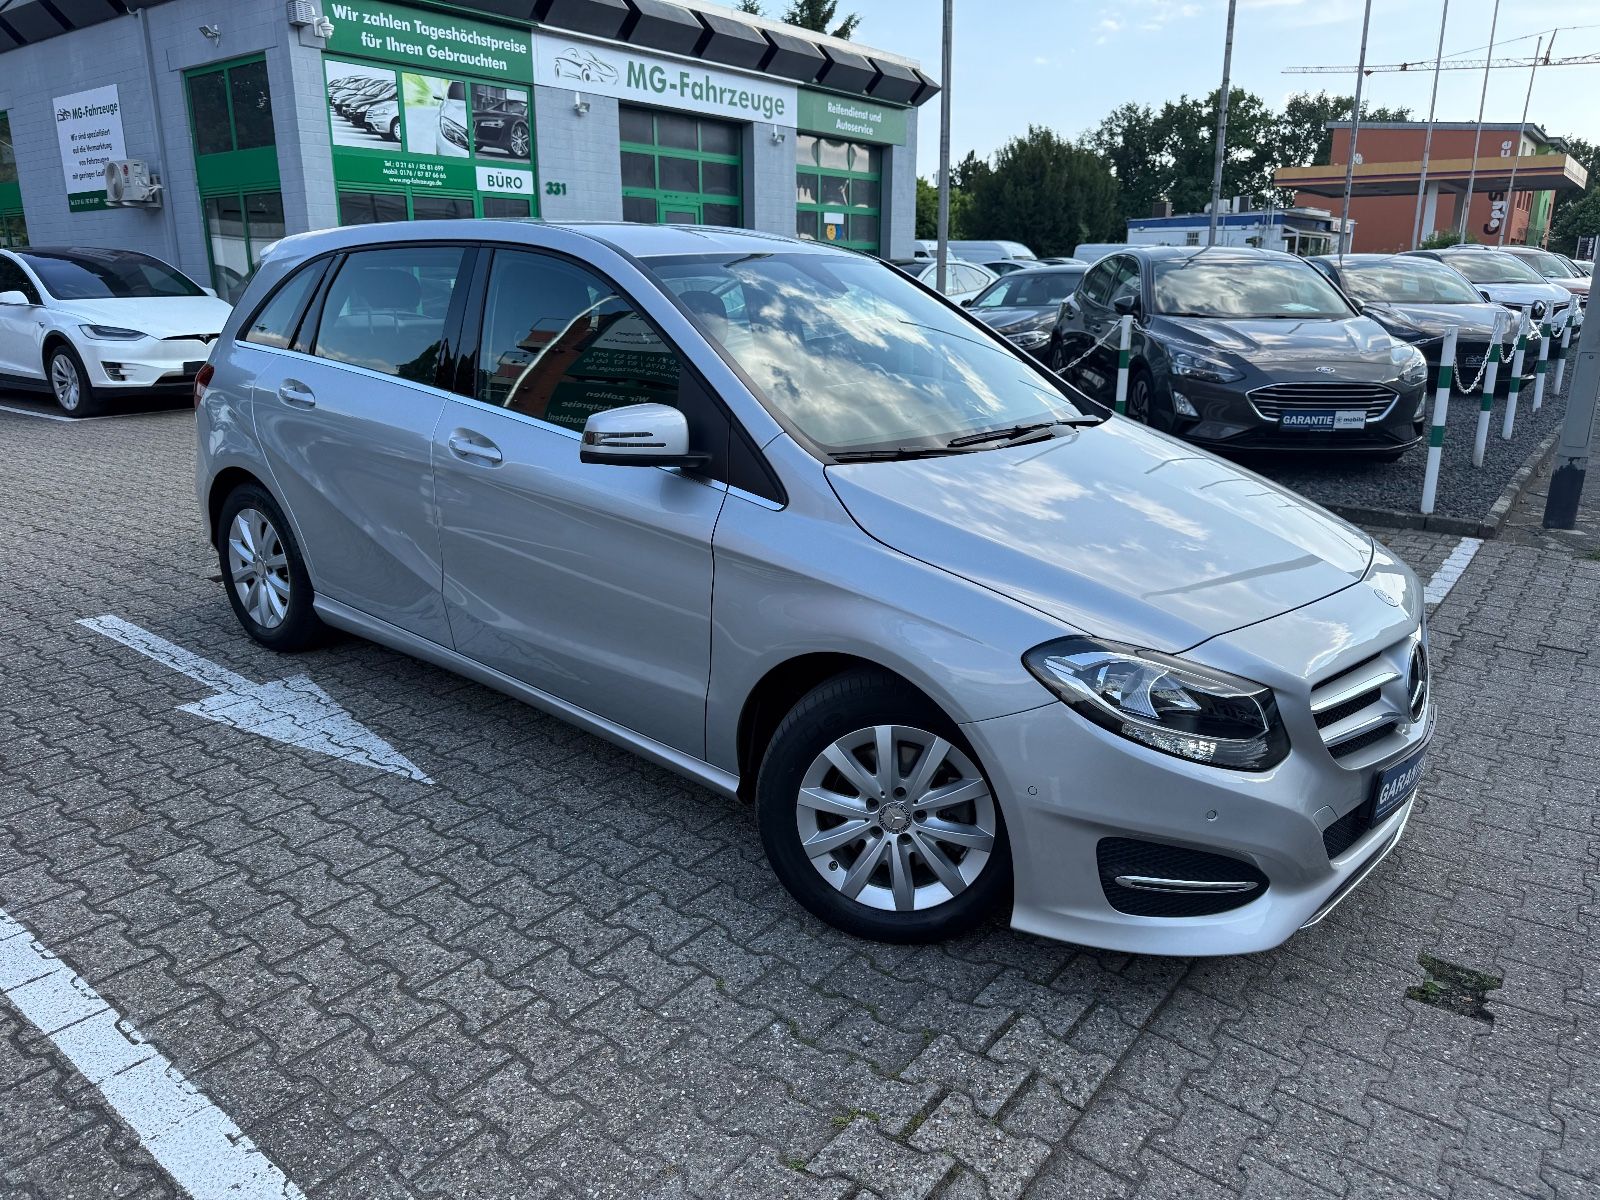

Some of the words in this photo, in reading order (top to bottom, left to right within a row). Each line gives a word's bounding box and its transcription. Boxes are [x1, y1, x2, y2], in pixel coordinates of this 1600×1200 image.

[332, 3, 358, 22] Wir
[363, 12, 411, 32] zahlen
[414, 19, 527, 54] Tageshöchstpreise
[361, 32, 383, 49] für
[386, 37, 423, 56] Ihren
[426, 44, 507, 71] Gebrauchten
[626, 60, 785, 120] MG-Fahrzeuge
[72, 102, 118, 120] MG-Fahrzeuge
[827, 102, 868, 119] Reifendienst
[869, 112, 882, 122] und
[836, 119, 873, 136] Autoservice
[487, 172, 523, 190] BÜRO
[545, 182, 567, 196] 331
[1283, 415, 1334, 425] GARANTIE
